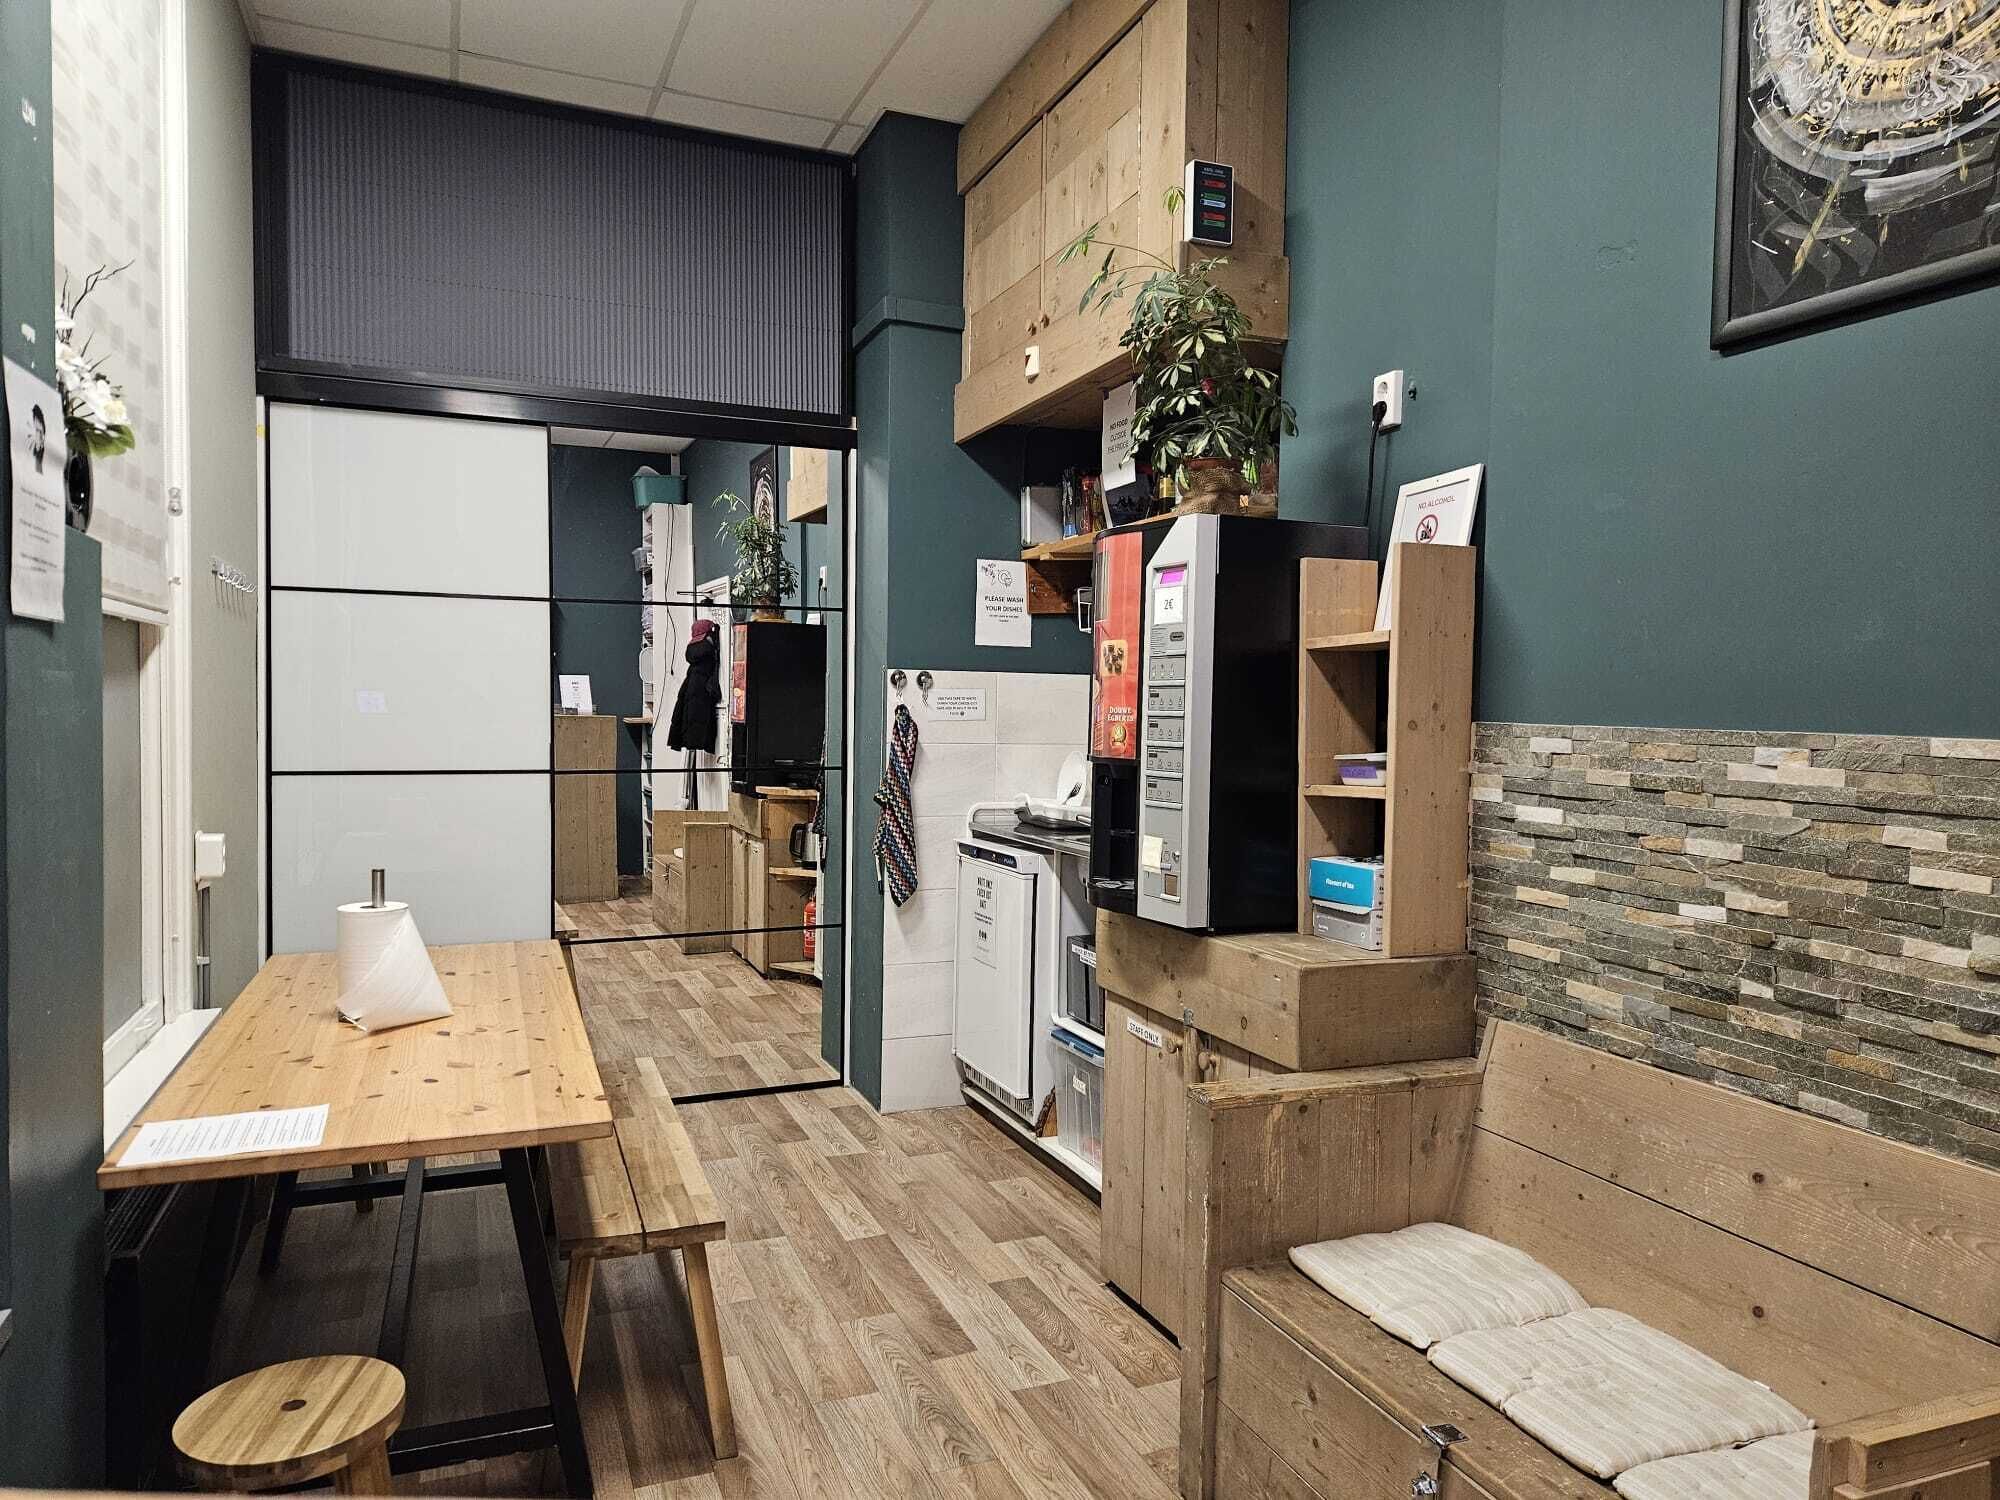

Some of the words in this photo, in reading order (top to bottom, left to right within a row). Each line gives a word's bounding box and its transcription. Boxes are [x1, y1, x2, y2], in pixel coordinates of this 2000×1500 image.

[1417, 502, 1427, 511] NO
[1427, 495, 1456, 507] ALCOHOL
[984, 595, 1005, 603] PLEASE
[1163, 598, 1174, 610] 2€
[1109, 706, 1132, 714] DOUWE
[1107, 713, 1134, 721] EGBERTS
[1129, 1022, 1143, 1035] STAFF
[1144, 1030, 1159, 1044] ONLY
